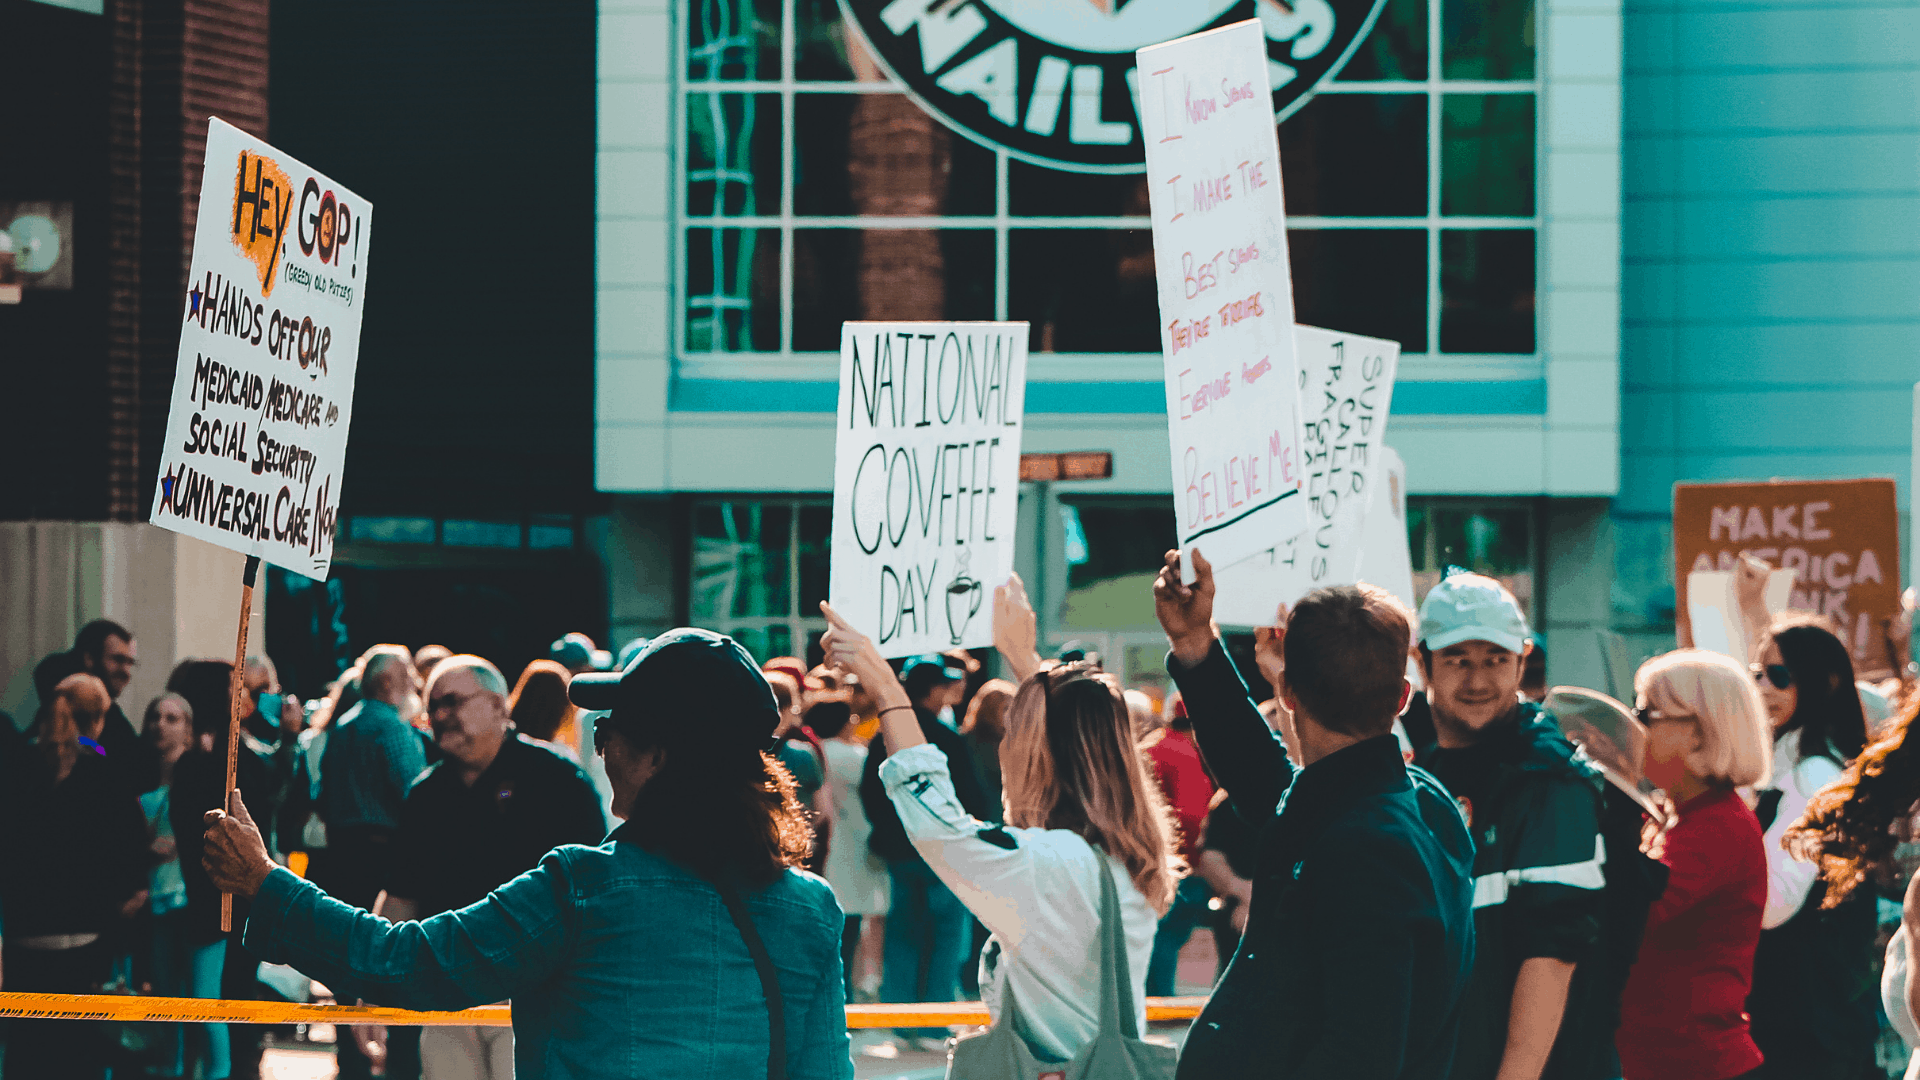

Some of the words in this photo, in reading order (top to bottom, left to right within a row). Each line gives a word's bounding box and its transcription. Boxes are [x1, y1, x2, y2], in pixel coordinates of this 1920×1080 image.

[880, 0, 1337, 144] NAILS
[1152, 66, 1183, 144] I
[1182, 73, 1217, 125] KNOW
[298, 177, 361, 279] GOP!
[1167, 174, 1184, 223] I
[1193, 173, 1232, 212] MAKE
[1237, 160, 1267, 198] THE
[284, 262, 313, 292] (GREEDY
[314, 274, 327, 293] OLD
[1181, 251, 1224, 299] BEST
[200, 270, 264, 346] HANDS
[268, 309, 299, 361] OFF
[298, 316, 331, 377] OUR
[850, 331, 1017, 430] NATIONAL
[1344, 355, 1383, 497] SUPER
[173, 462, 270, 542] UNIVERSAL
[273, 485, 311, 549] CARE
[184, 412, 248, 463] SOCIAL
[251, 430, 317, 512] SECURITY
[851, 438, 1000, 555] COVFEFE
[1184, 446, 1262, 529] BELIEVE
[1310, 398, 1355, 582] CALLOUS
[1709, 501, 1831, 542] MAKE
[879, 558, 937, 645] DAY
